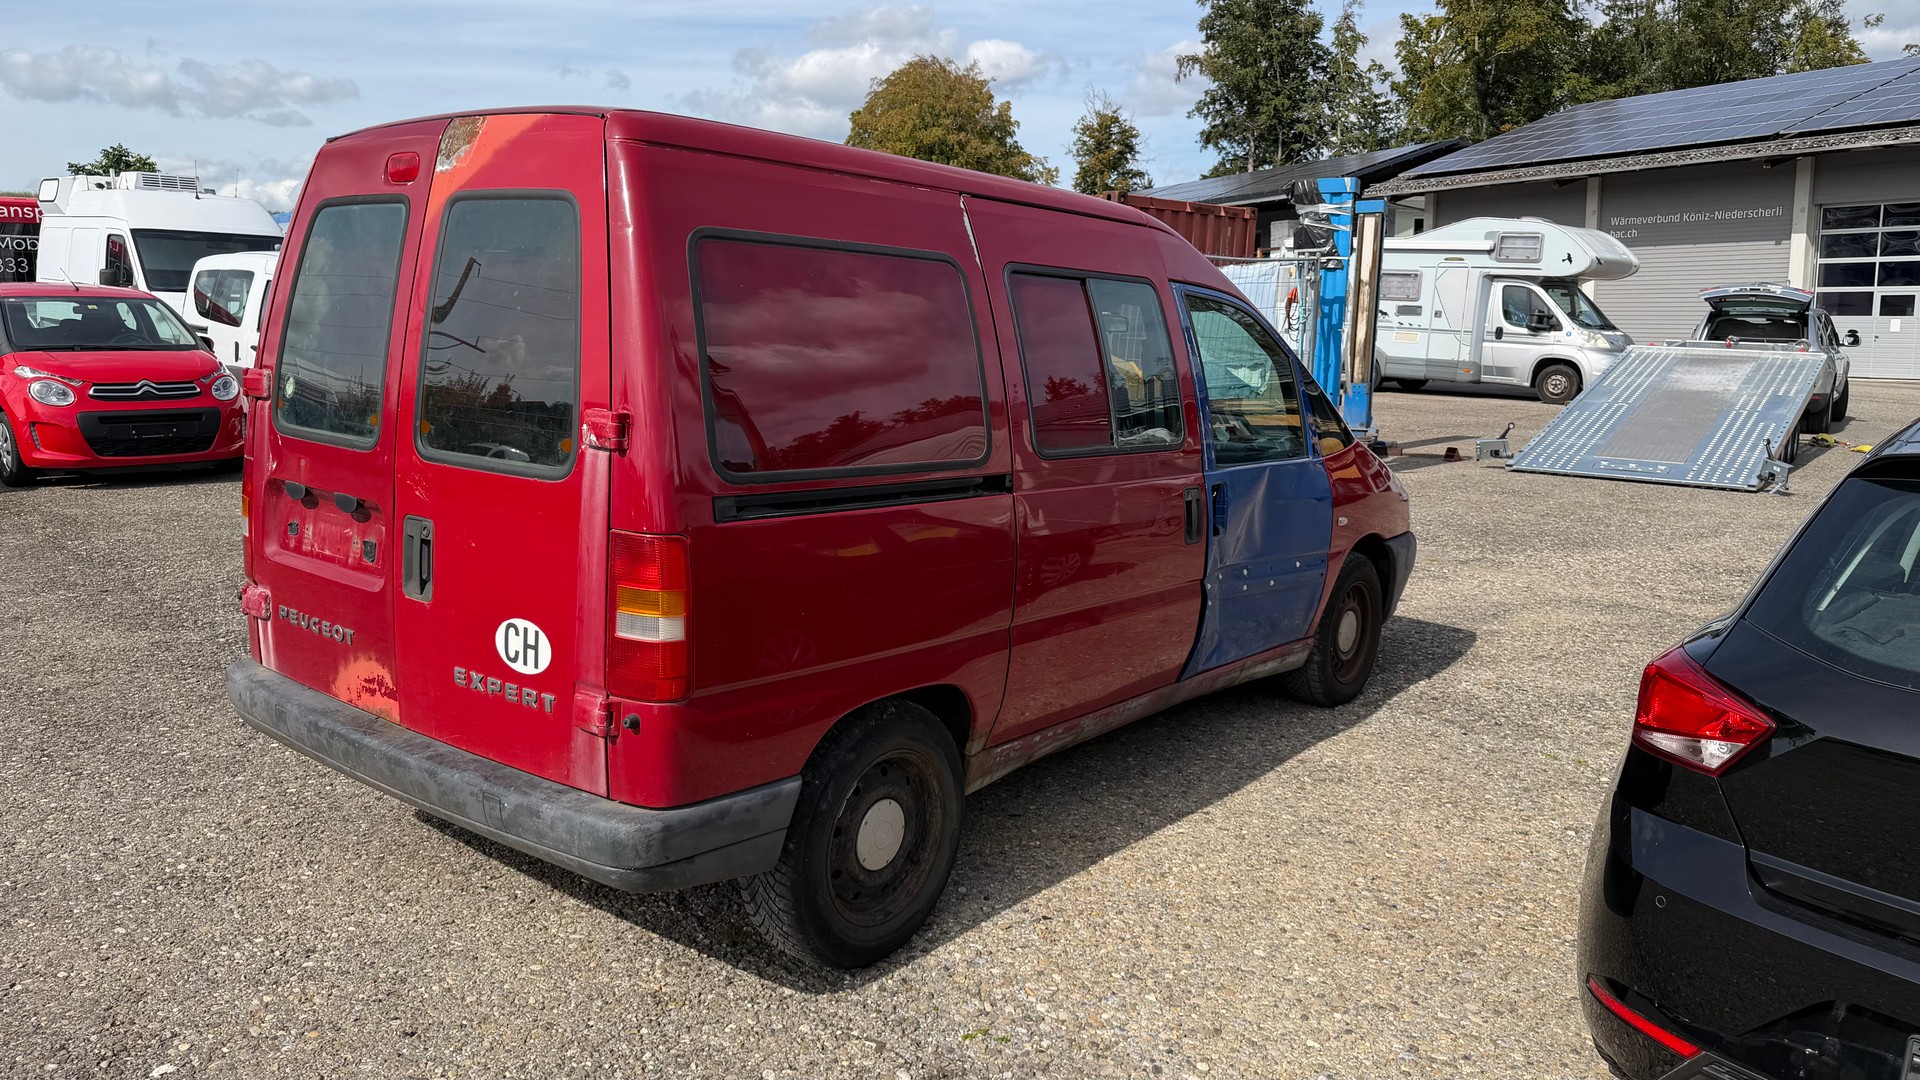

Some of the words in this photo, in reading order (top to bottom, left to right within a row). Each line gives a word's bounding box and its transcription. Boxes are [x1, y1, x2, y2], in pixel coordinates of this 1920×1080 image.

[1610, 213, 1681, 226] Wärmeverbund
[1683, 206, 1783, 222] Köniz-Niederscherli
[278, 605, 355, 646] PEUGEOT
[504, 622, 540, 670] CH
[453, 667, 556, 713] EXPERT
